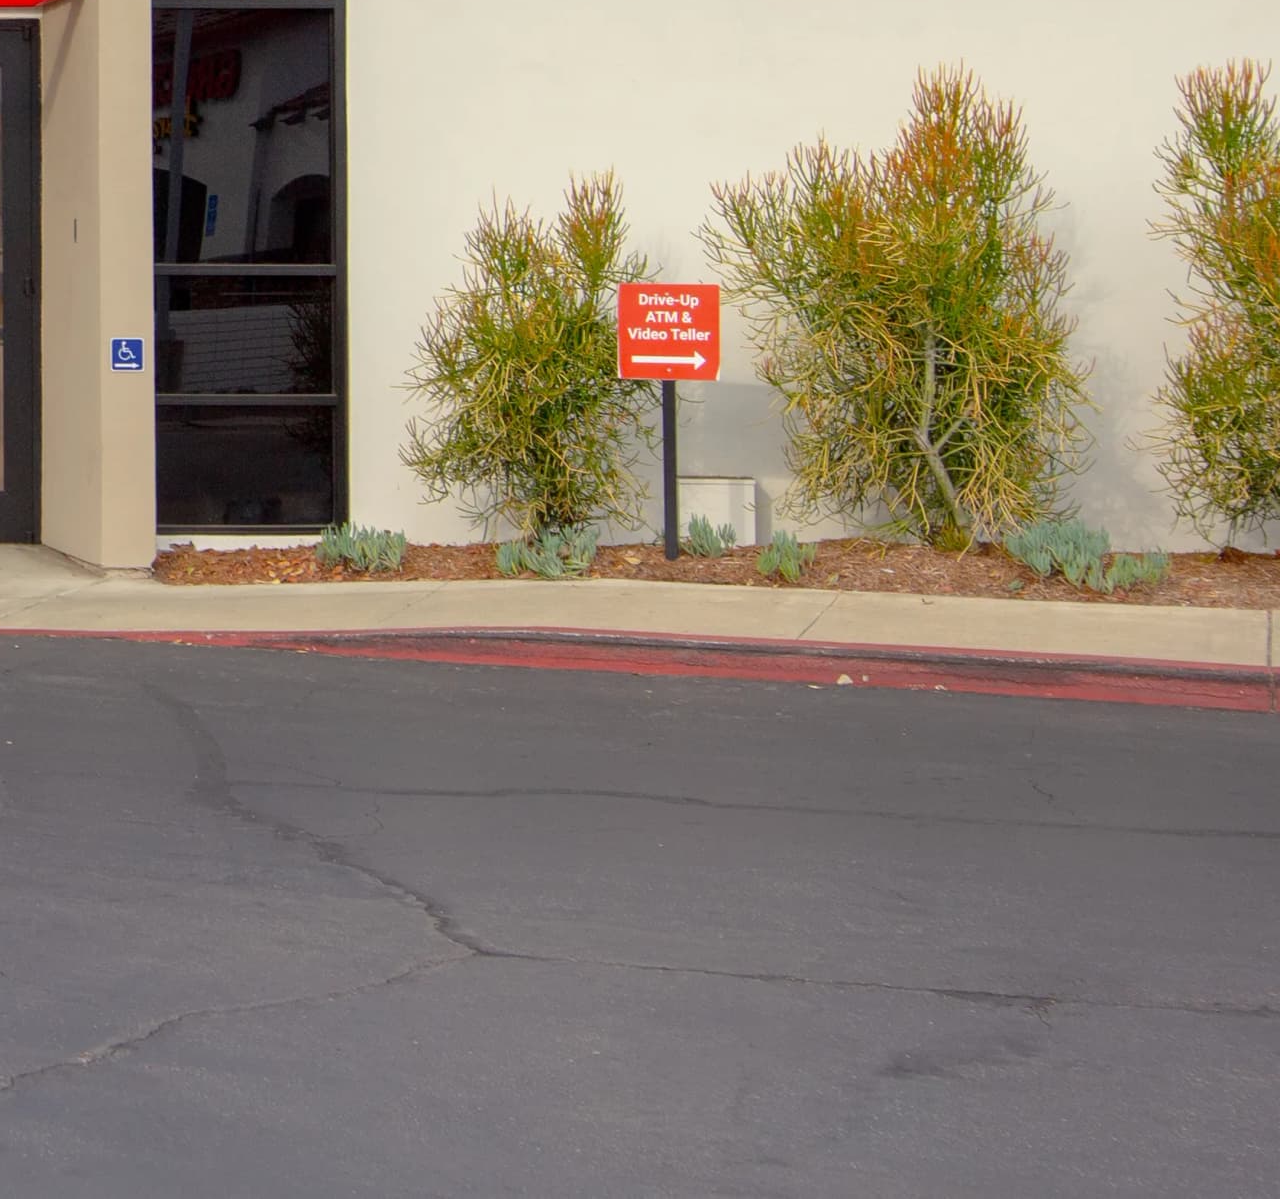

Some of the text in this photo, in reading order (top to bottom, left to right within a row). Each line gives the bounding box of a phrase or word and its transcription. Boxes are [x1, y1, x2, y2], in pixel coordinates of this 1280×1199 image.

[638, 293, 699, 309] Drive-Up
[645, 311, 692, 323] ATM &
[627, 328, 711, 341] Video Teller
